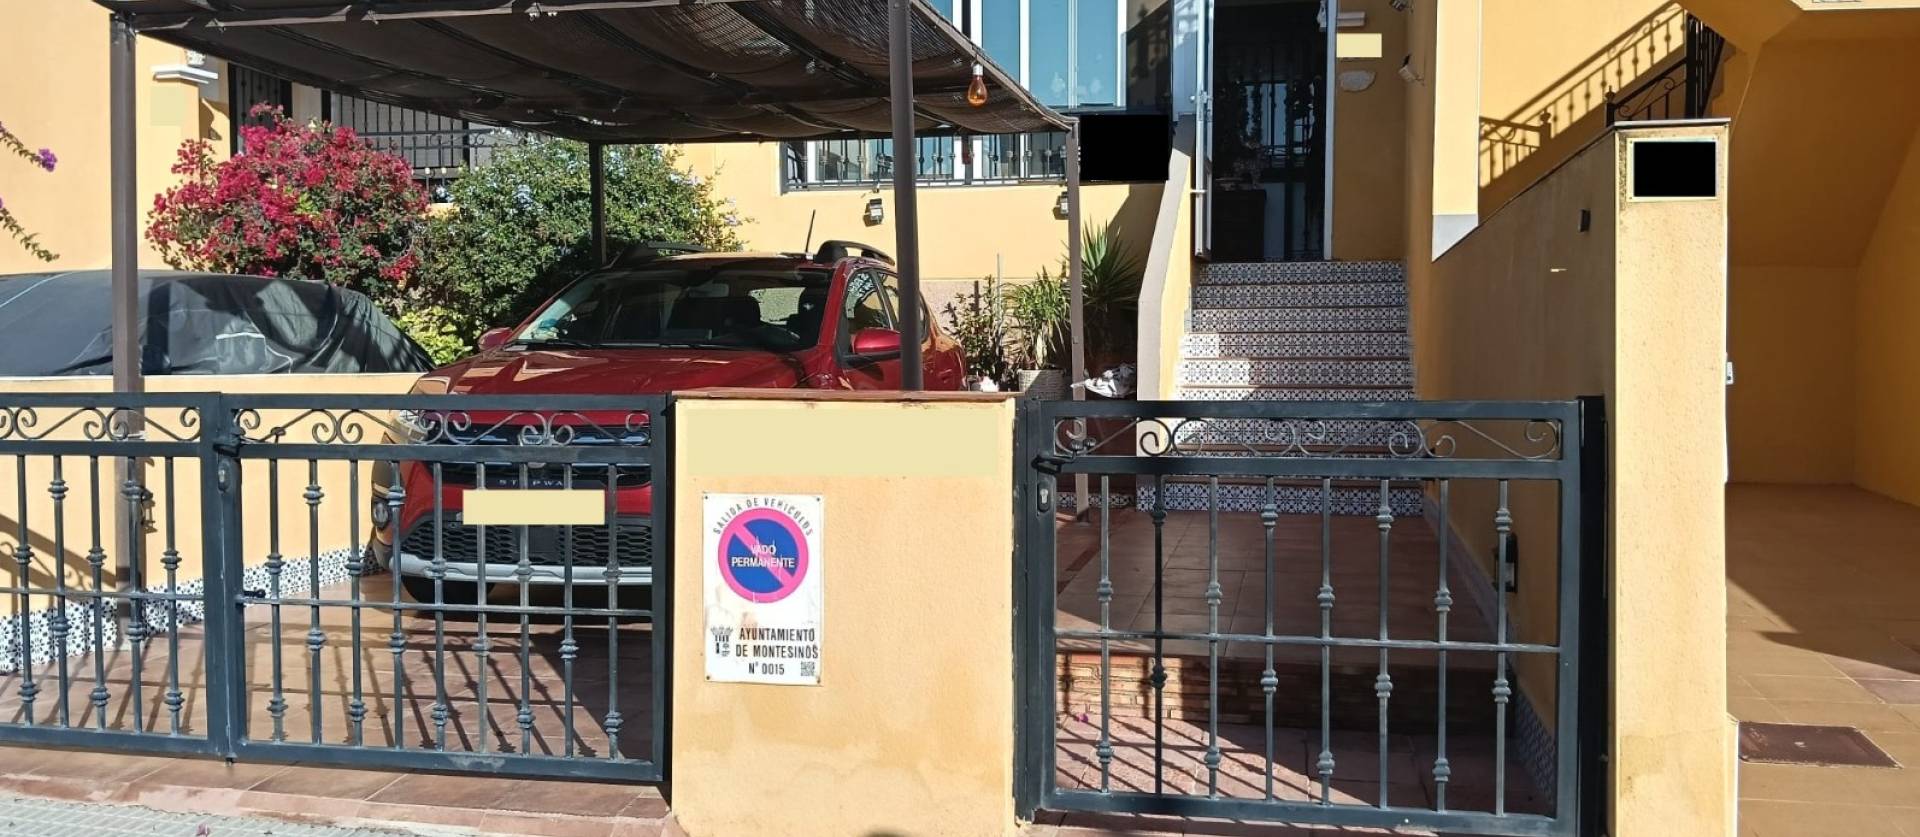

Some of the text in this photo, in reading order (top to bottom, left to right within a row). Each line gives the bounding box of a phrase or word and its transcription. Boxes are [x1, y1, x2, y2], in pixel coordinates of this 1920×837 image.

[713, 497, 813, 536] SALIDA DE VEHICULOS
[751, 544, 777, 555] VADO
[731, 556, 795, 568] PERMANENTE
[739, 627, 815, 642] AYUNTAMIENTO
[735, 644, 818, 659] DE MONTESINOS
[761, 663, 785, 675] 0015
